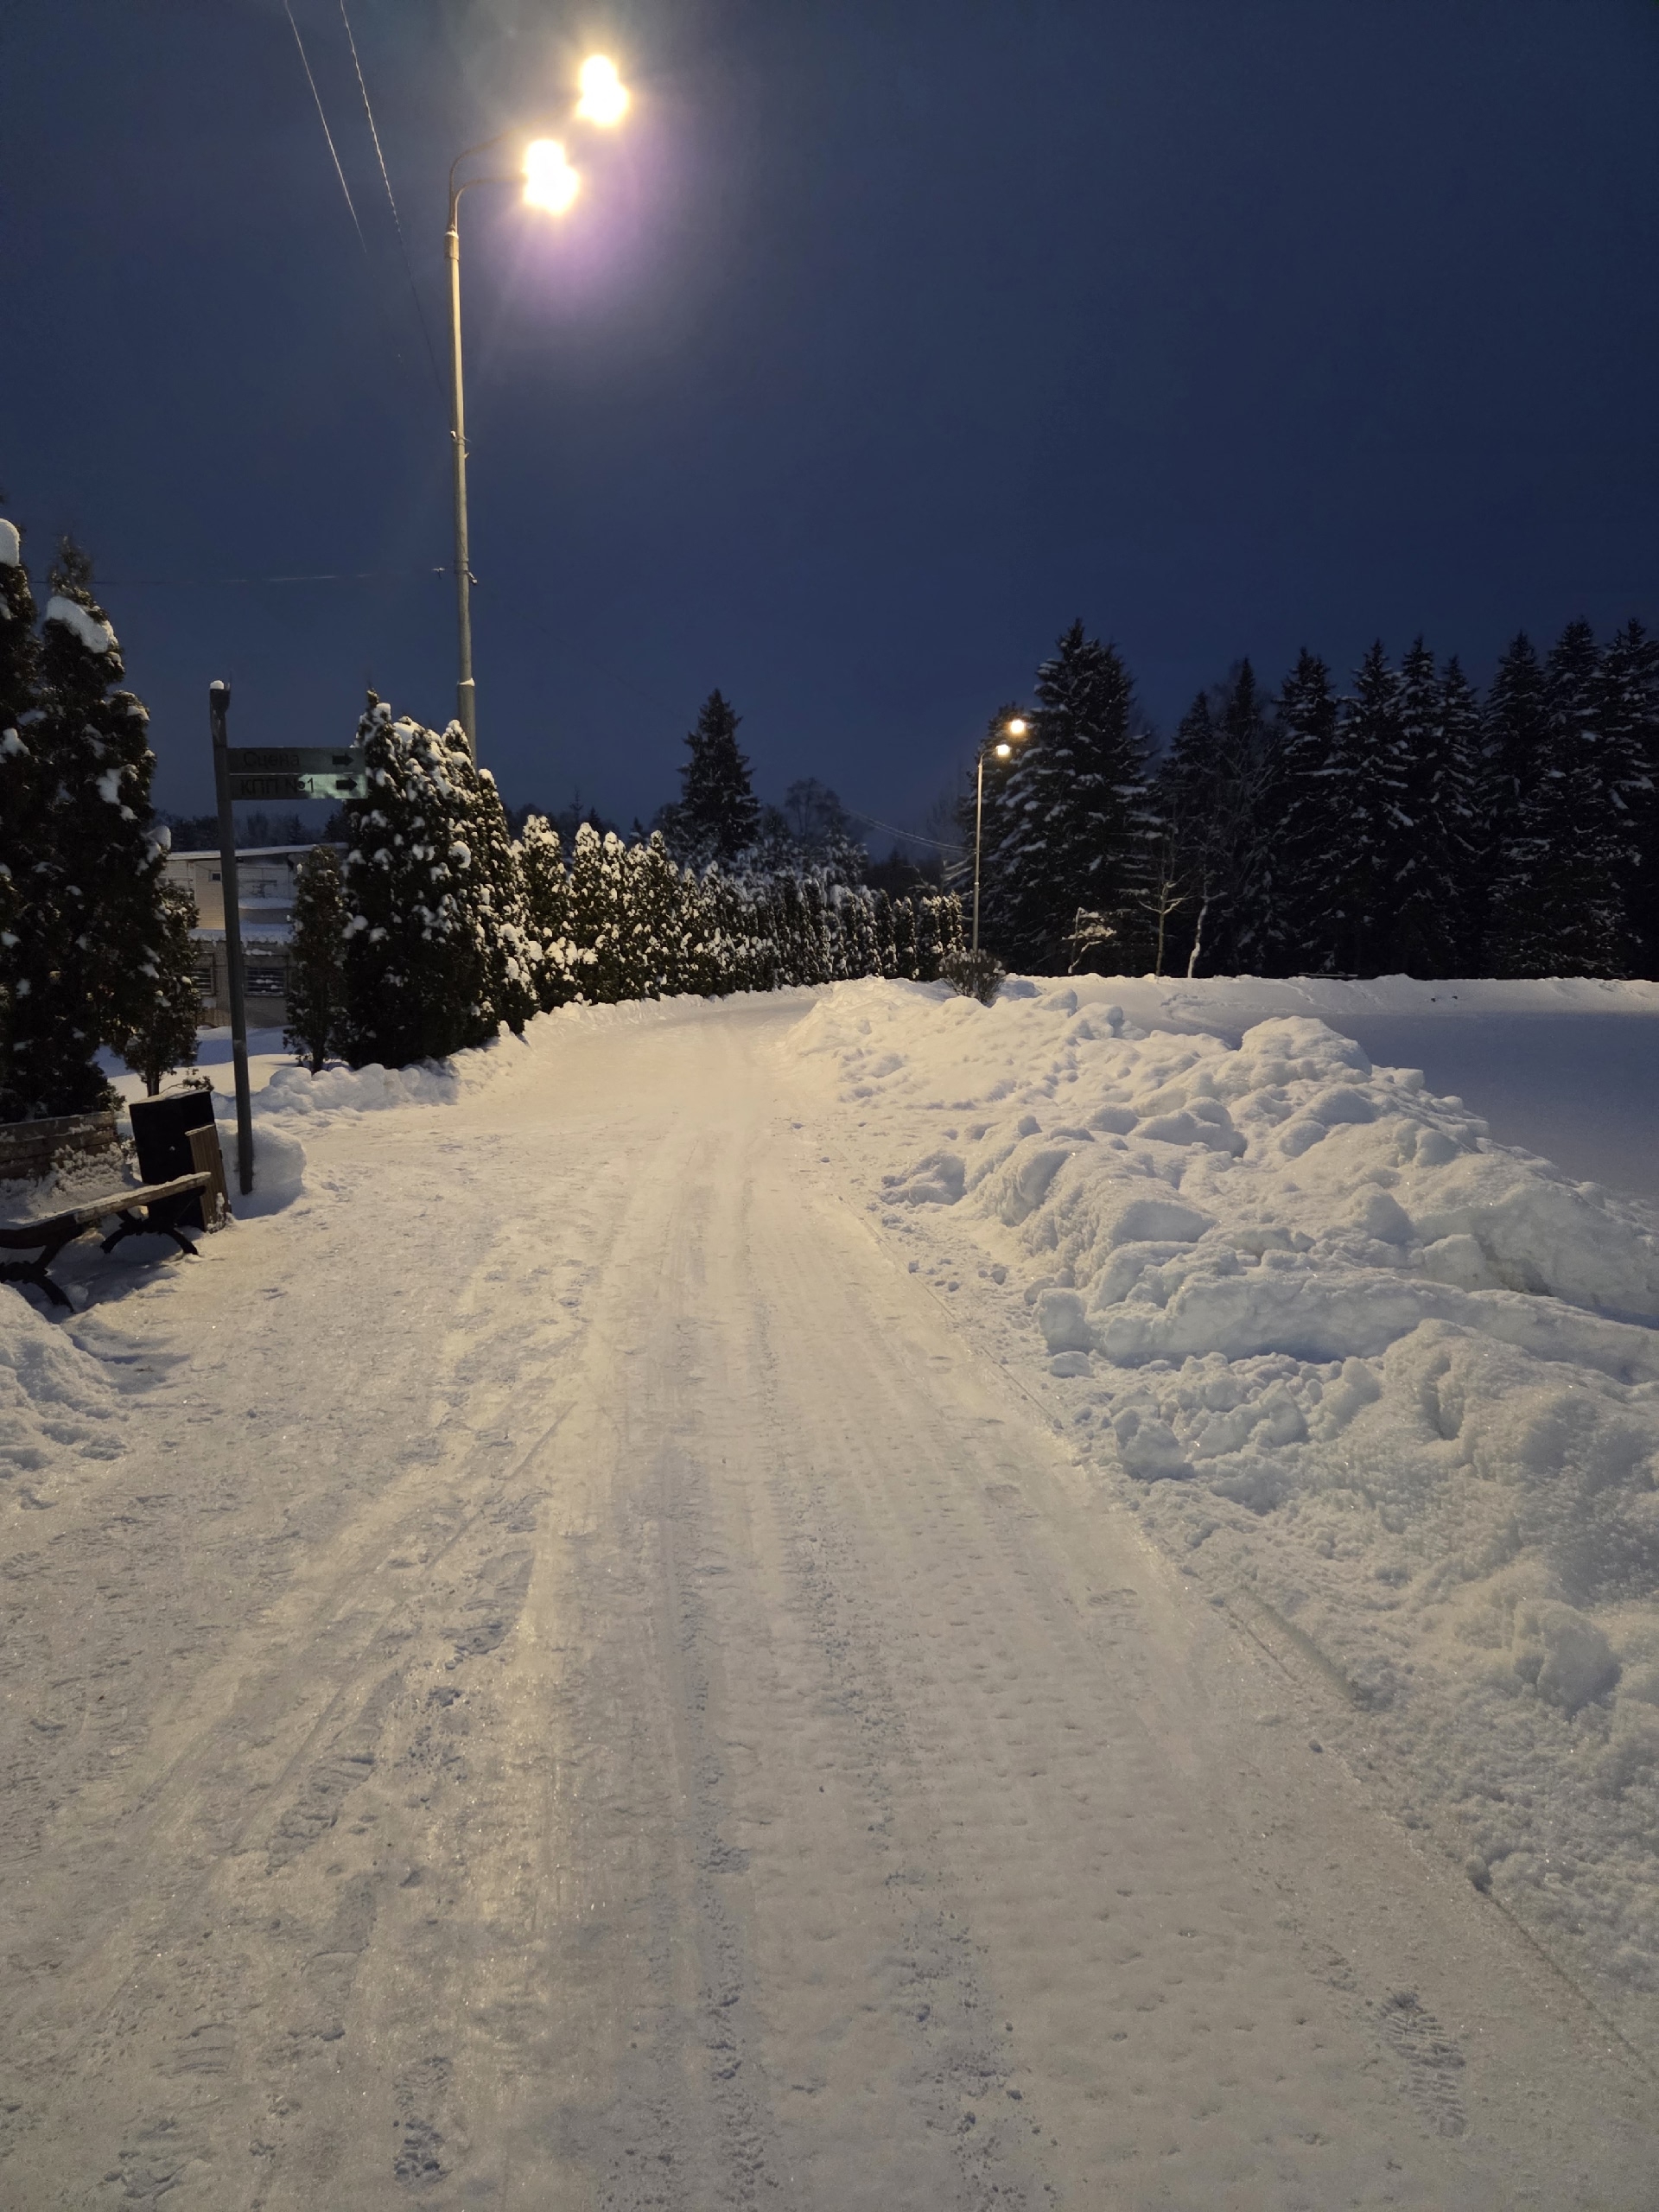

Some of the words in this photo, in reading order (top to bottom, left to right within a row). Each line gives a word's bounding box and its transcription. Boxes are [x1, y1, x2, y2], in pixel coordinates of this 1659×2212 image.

[243, 751, 300, 768] Сцена
[241, 778, 278, 795] КПП
[285, 777, 315, 794] №1
